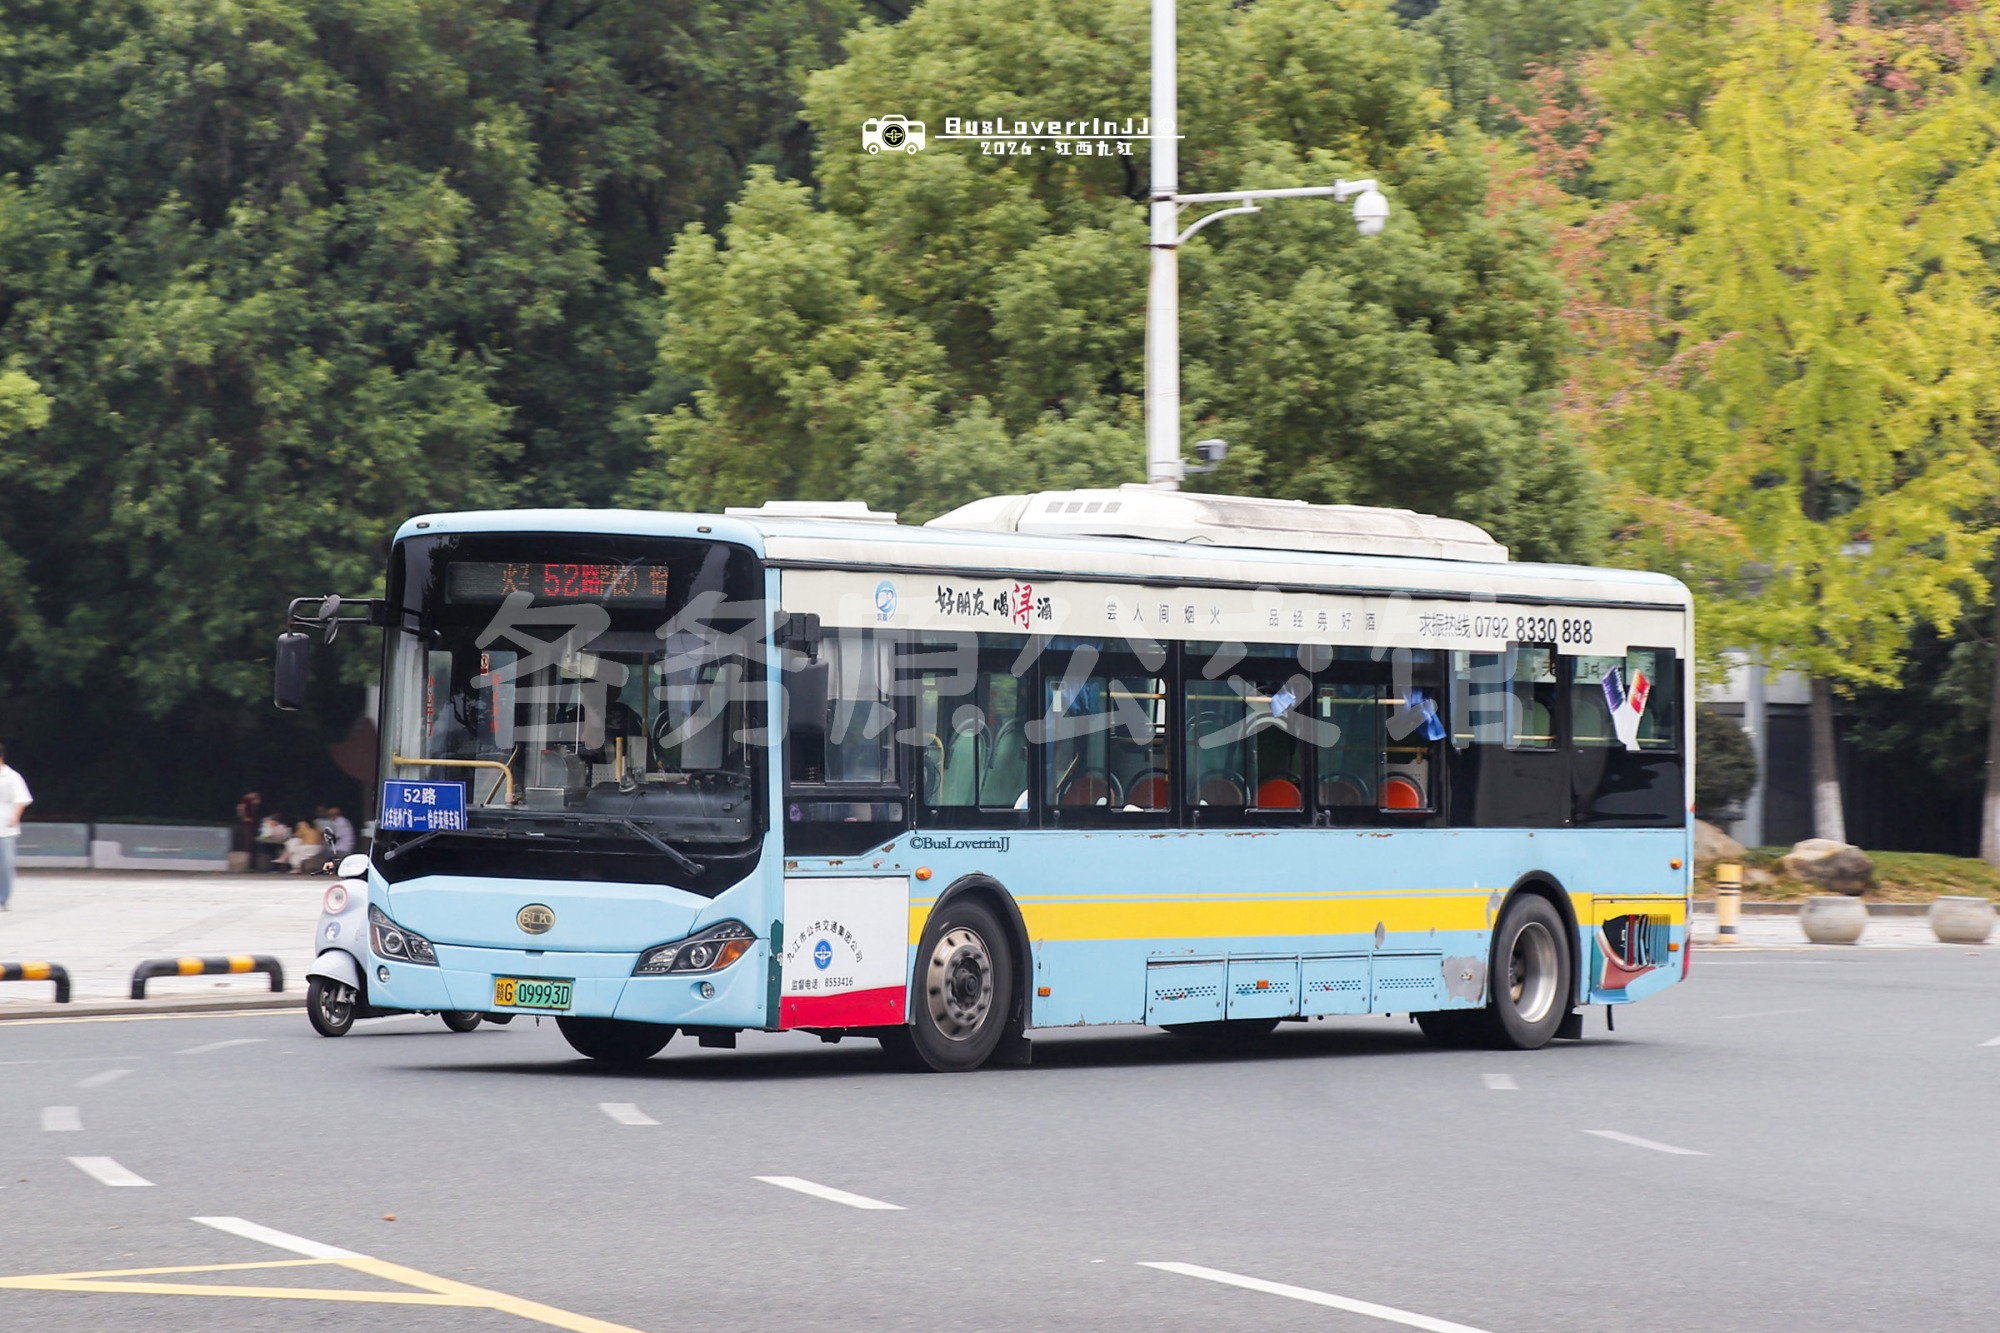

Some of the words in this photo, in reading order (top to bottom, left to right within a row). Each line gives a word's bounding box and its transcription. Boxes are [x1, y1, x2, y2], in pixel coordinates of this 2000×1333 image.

[1475, 616, 1508, 639] 0792
[1516, 616, 1556, 643] 8330
[1562, 619, 1593, 644] 888
[403, 787, 436, 806] 52路
[786, 919, 864, 964] 九江市公共交通集团公司
[824, 976, 854, 989] 8553416
